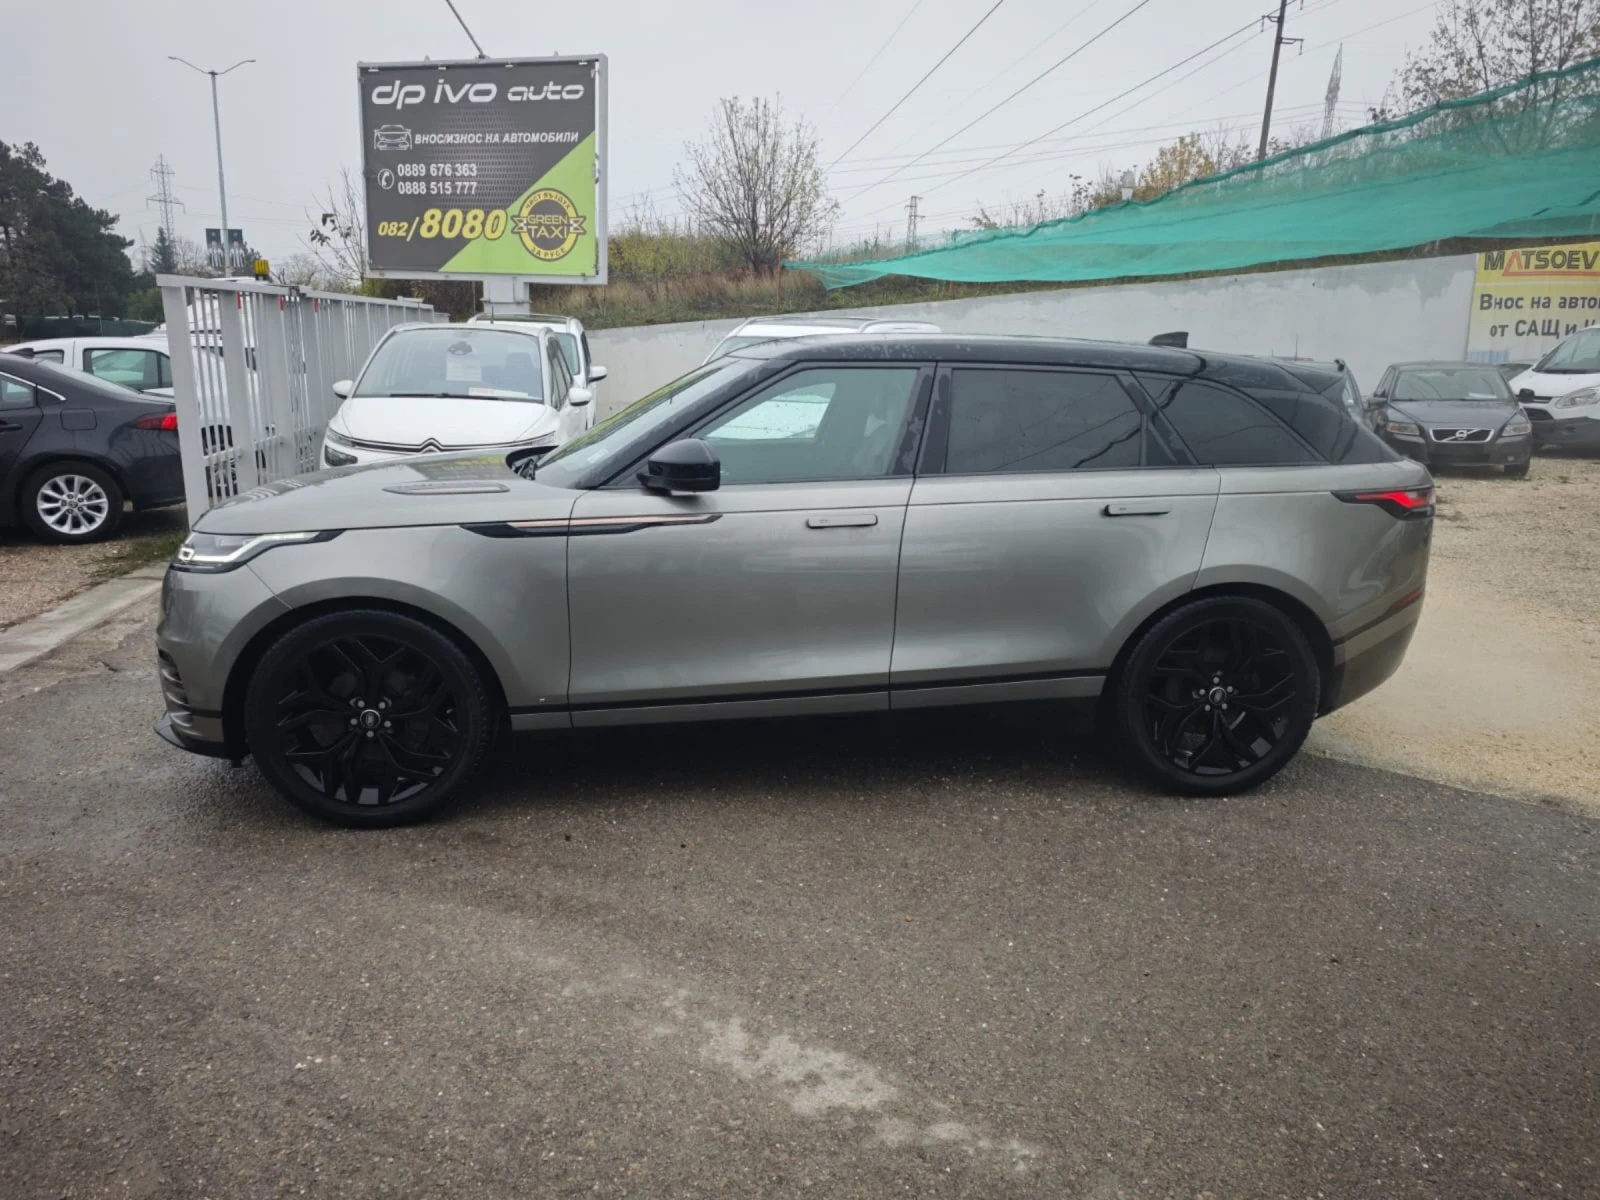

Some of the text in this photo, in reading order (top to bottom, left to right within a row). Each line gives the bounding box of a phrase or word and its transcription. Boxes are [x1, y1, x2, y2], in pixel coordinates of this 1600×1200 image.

[371, 79, 585, 110] dp ivo auto
[414, 131, 580, 145] ВНОС/ИЗНОС НА АВТОМОБИЛИ
[397, 163, 478, 177] 0889 676 363
[398, 181, 478, 195] 0888 515 777
[377, 208, 508, 242] 082/8080
[527, 214, 568, 225] GREEN
[527, 225, 568, 239] TAXI
[1484, 250, 1600, 271] MATSOEV
[1480, 293, 1600, 310] Внос на авто
[1490, 324, 1509, 337] от
[1515, 319, 1560, 340] САЩ
[1565, 323, 1577, 336] и
